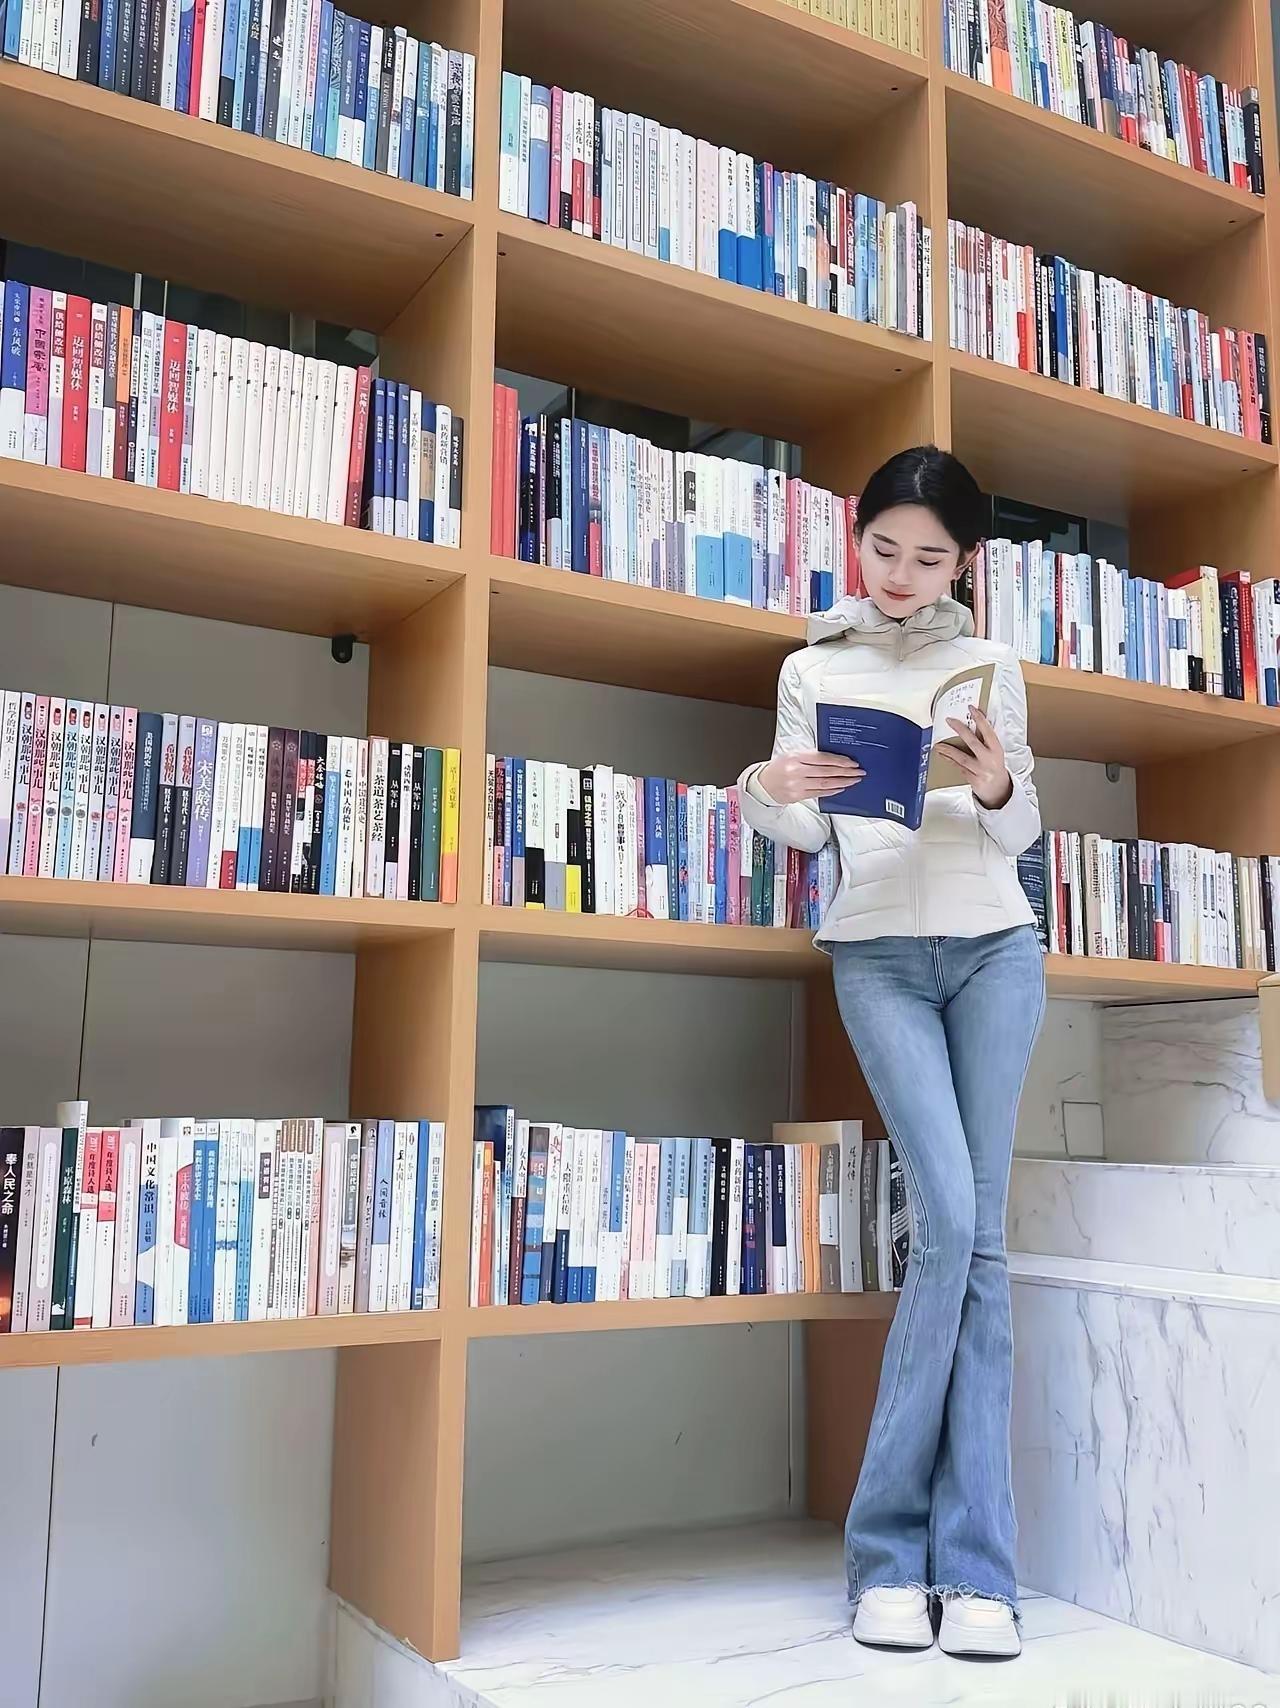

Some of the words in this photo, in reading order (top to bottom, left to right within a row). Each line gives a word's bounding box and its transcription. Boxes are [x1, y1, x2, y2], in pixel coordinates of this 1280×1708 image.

[18, 724, 32, 785] 汉朝那些事儿
[32, 729, 45, 788] 汉朝那些事儿
[48, 731, 61, 791] 汉朝那些事儿
[64, 731, 77, 791] 汉朝那些事儿
[78, 734, 90, 794] 汉朝那些事儿
[93, 735, 105, 795] 汉朝那些事儿
[108, 737, 120, 796] 汉朝那些事儿
[122, 741, 134, 799] 汉朝那些事儿
[195, 759, 212, 821] 宋美龄传
[144, 1142, 157, 1214] 中国文化常识
